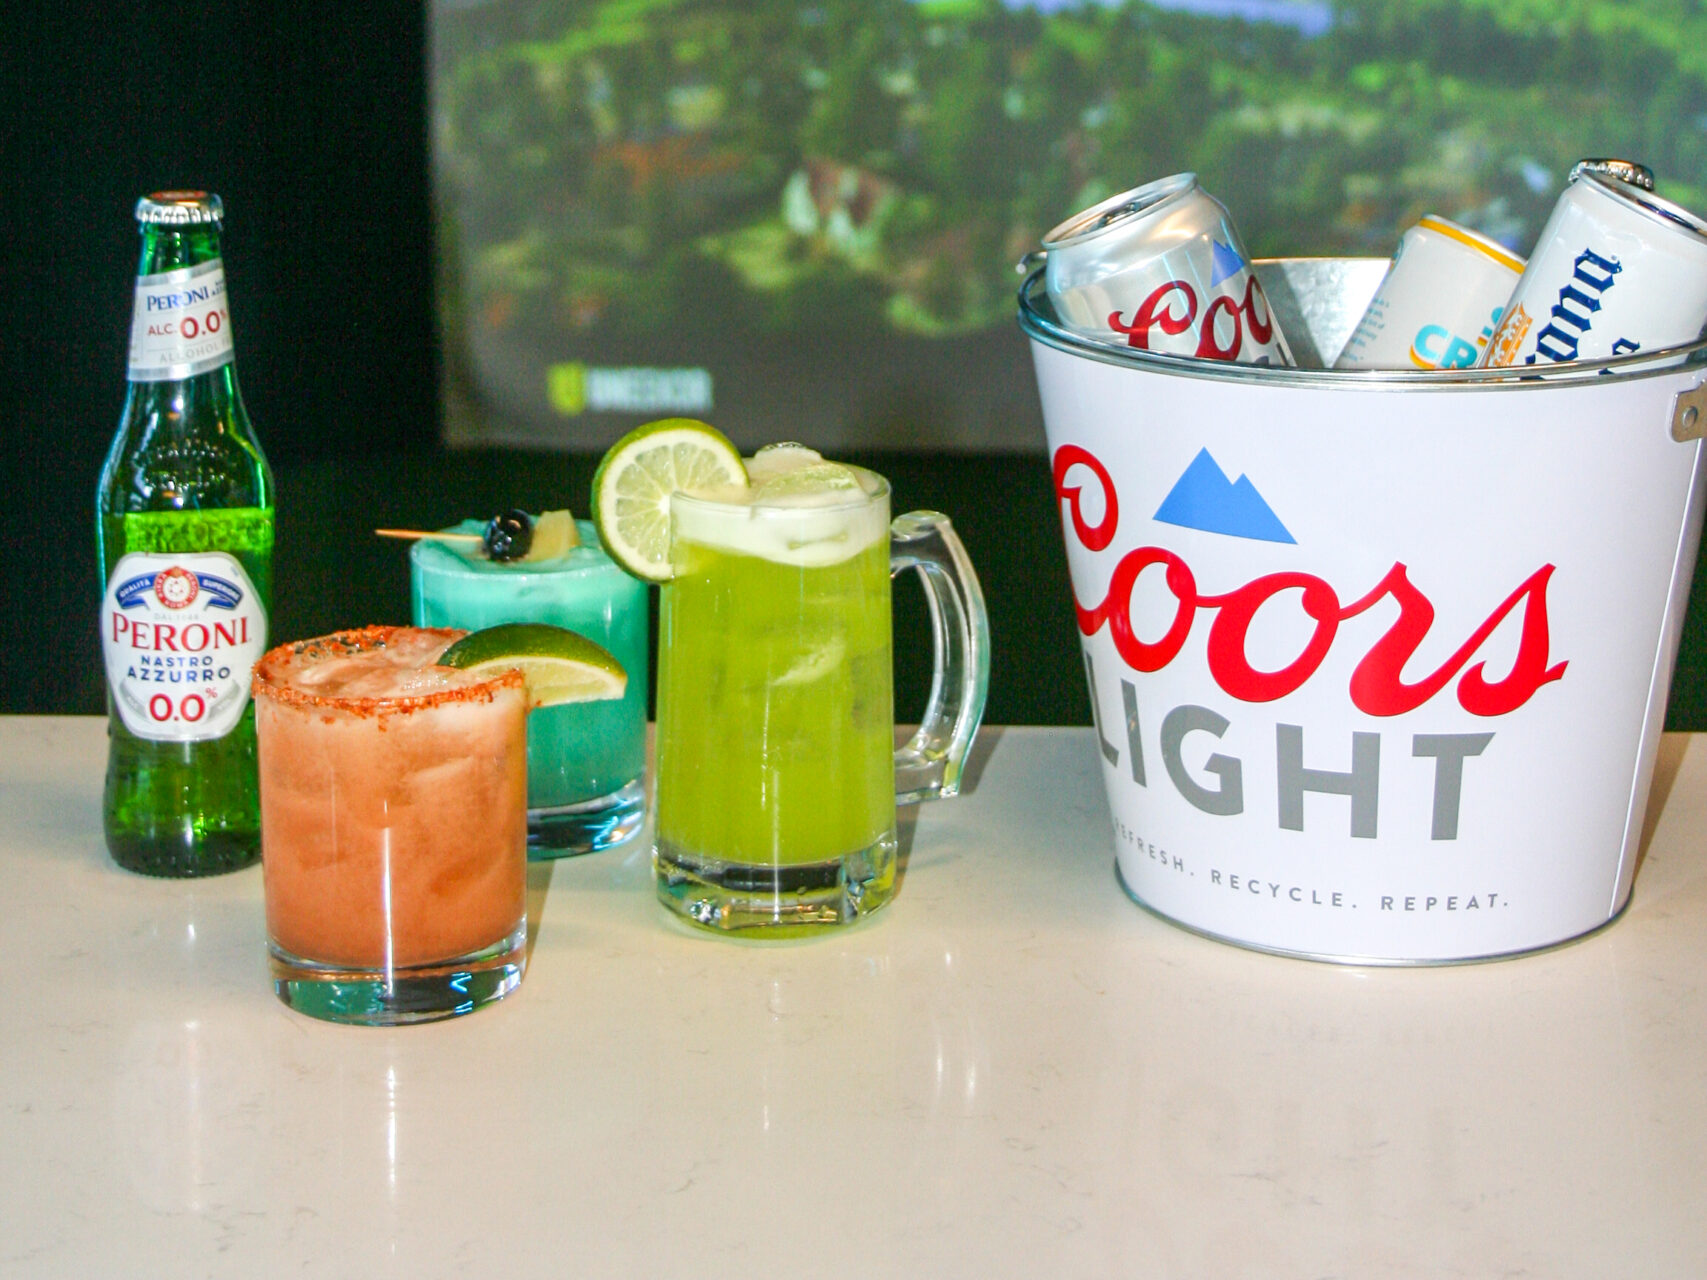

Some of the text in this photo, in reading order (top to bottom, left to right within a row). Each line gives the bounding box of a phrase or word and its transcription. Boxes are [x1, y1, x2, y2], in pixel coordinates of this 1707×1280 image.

[147, 286, 209, 311] PERONI
[1526, 248, 1623, 364] ona
[1053, 444, 1570, 717] Coors
[112, 611, 251, 652] PERONI
[127, 666, 230, 683] AZZURRO
[141, 655, 213, 667] NASTRO
[1086, 651, 1496, 841] LIGHT
[1211, 869, 1358, 910] RECYCLE.
[1381, 894, 1510, 912] REPEAT.
